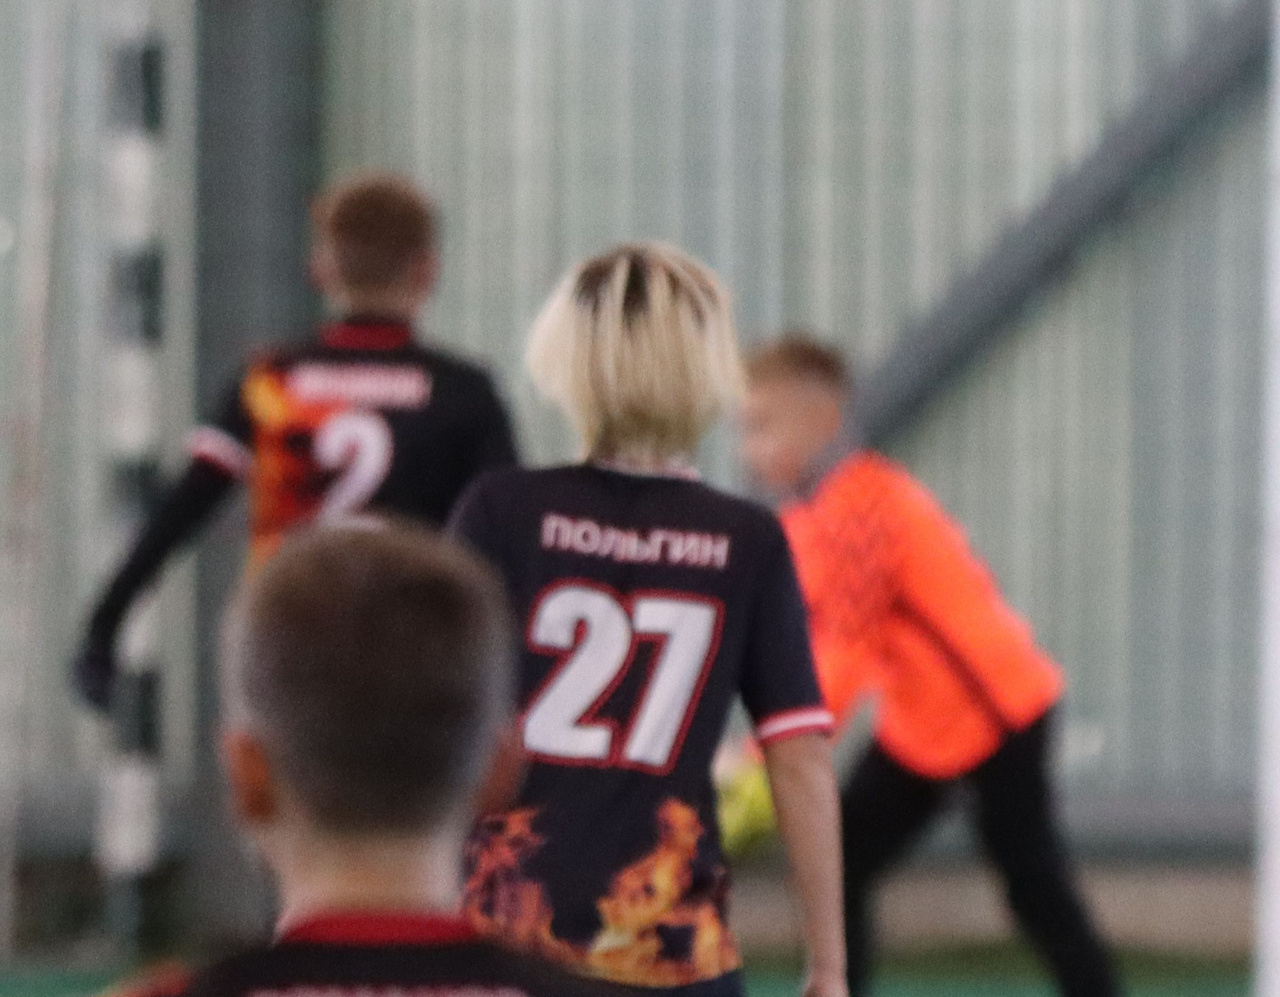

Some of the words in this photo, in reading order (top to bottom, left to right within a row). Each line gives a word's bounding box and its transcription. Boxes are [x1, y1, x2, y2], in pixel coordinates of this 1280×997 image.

[315, 410, 392, 528] 2
[541, 513, 729, 568] ПОЛЬГИН
[520, 580, 722, 771] 27
